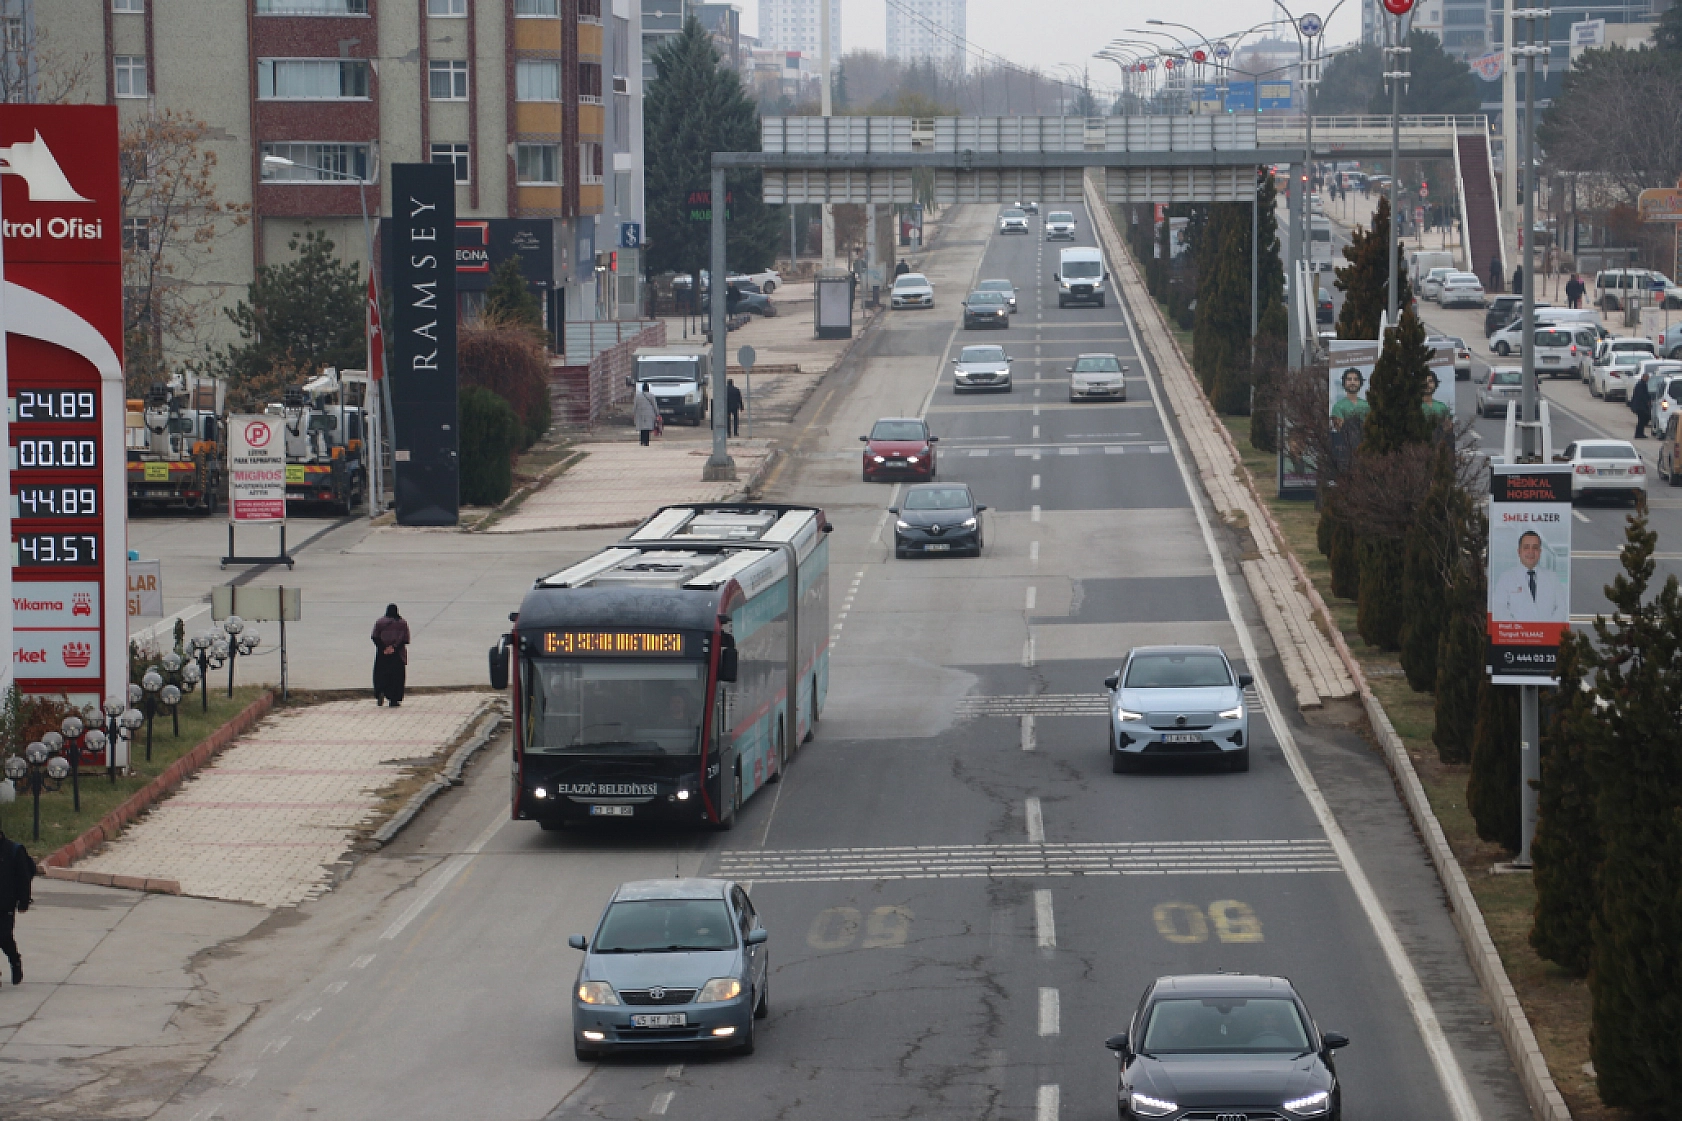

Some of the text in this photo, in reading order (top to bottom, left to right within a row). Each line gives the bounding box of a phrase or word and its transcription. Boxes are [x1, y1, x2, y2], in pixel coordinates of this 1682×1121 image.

[688, 192, 732, 204] ANKA
[3, 217, 103, 239] trol Ofisi
[410, 196, 439, 371] RAMSEY
[19, 392, 95, 418] 24.89
[20, 440, 96, 467] 00.00
[20, 489, 96, 514] 44.89
[1503, 513, 1560, 522] SMILE LAZER
[21, 536, 96, 562] 43.57
[128, 574, 157, 591] LAR
[13, 647, 47, 663] rket
